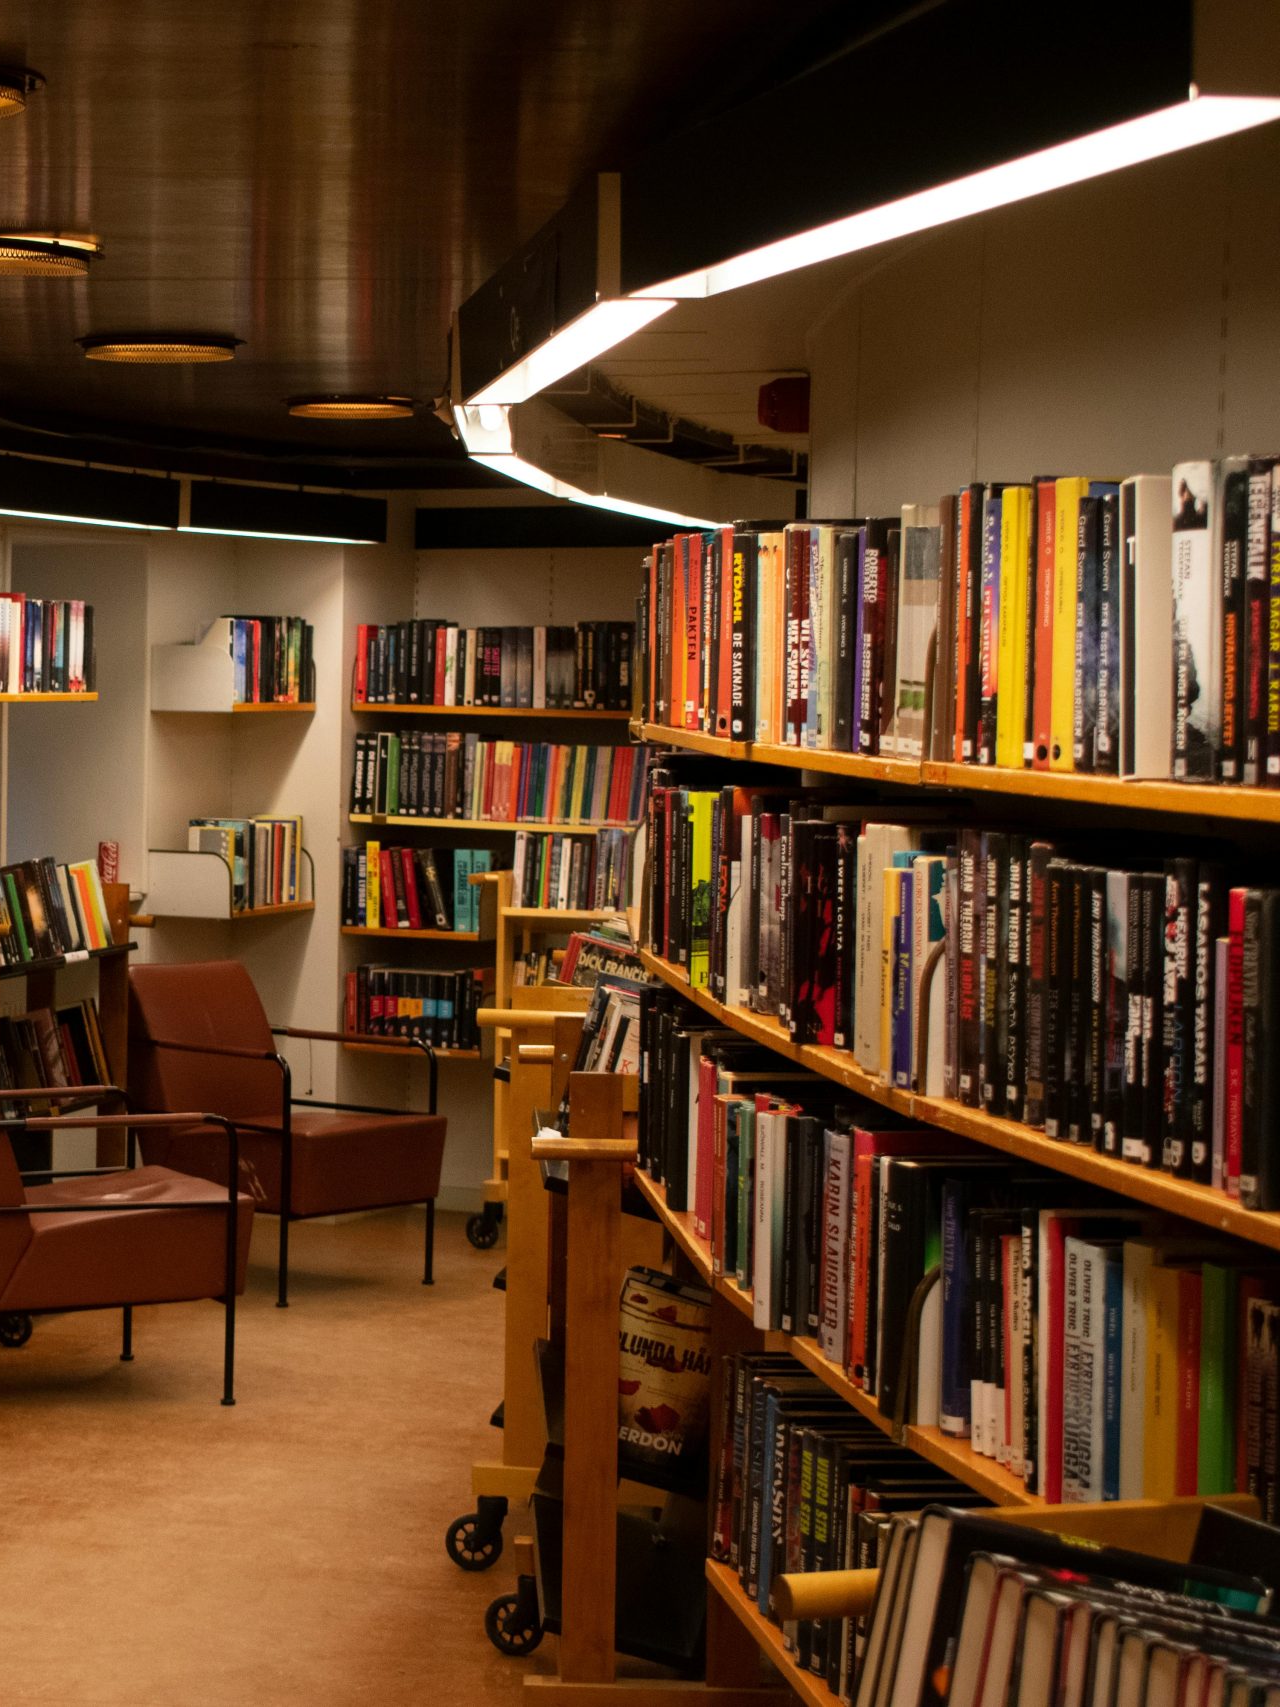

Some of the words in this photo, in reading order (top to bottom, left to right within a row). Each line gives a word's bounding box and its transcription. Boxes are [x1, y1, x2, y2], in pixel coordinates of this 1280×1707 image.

[1230, 541, 1239, 578] STEFAN
[732, 552, 742, 624] RYDAHL
[687, 606, 698, 661] PAKTEN
[732, 632, 742, 647] DE
[731, 651, 742, 706] SAKNADE
[1222, 613, 1237, 747] NIRVANAPROJEKTET
[836, 858, 844, 902] SWEET
[835, 906, 843, 951] LOLITA
[1195, 882, 1211, 1001] LASAROS
[577, 952, 603, 973] DICK
[604, 960, 649, 983] FRANCIS
[827, 1157, 841, 1218] KARIN
[1067, 1252, 1077, 1299] OLIVIER
[1082, 1259, 1092, 1306] OLIVIER
[1067, 1300, 1077, 1330] TRUC
[1082, 1307, 1092, 1338] TRUC
[618, 1425, 683, 1456] ERDON
[800, 1449, 813, 1500] VIVECA
[813, 1457, 830, 1507] VIVECA
[799, 1501, 813, 1536] STEN
[813, 1508, 829, 1544] STEN
